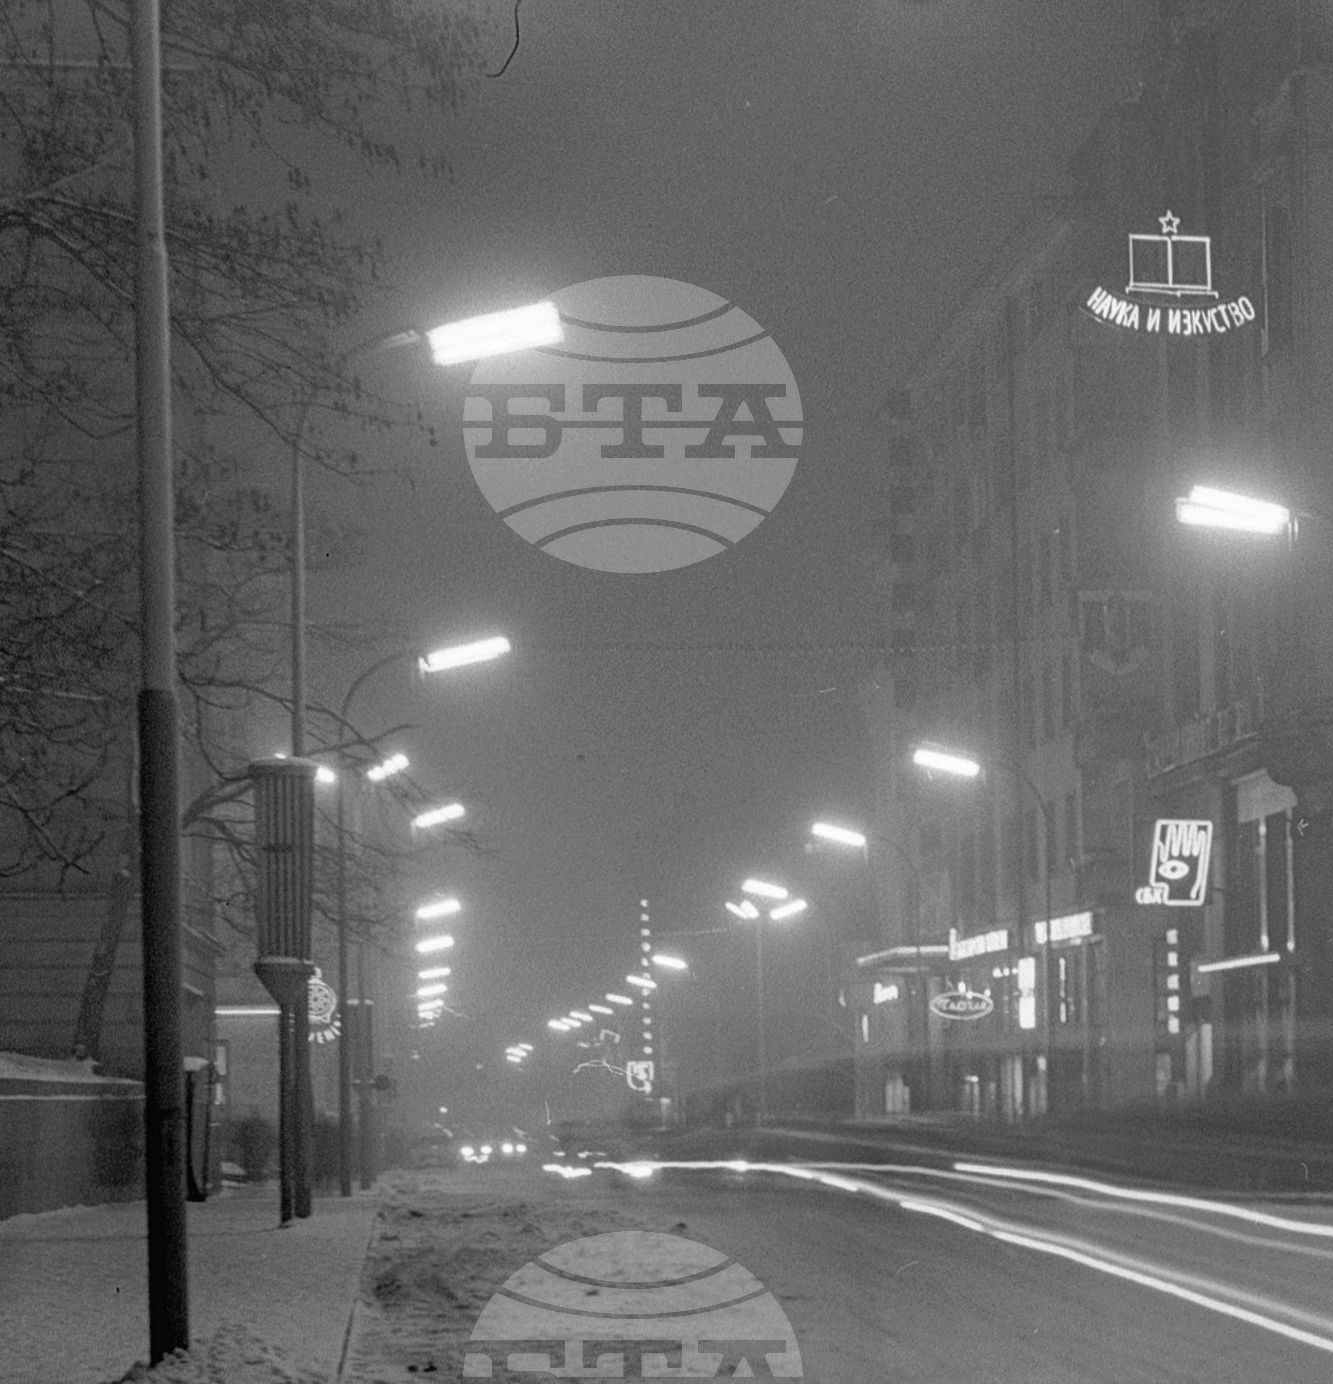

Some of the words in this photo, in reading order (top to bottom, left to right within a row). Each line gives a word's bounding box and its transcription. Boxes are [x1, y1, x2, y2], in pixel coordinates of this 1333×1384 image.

[1086, 285, 1139, 330] НАУКА
[1146, 307, 1161, 333] И
[1168, 296, 1256, 336] ИЗКУСТВО
